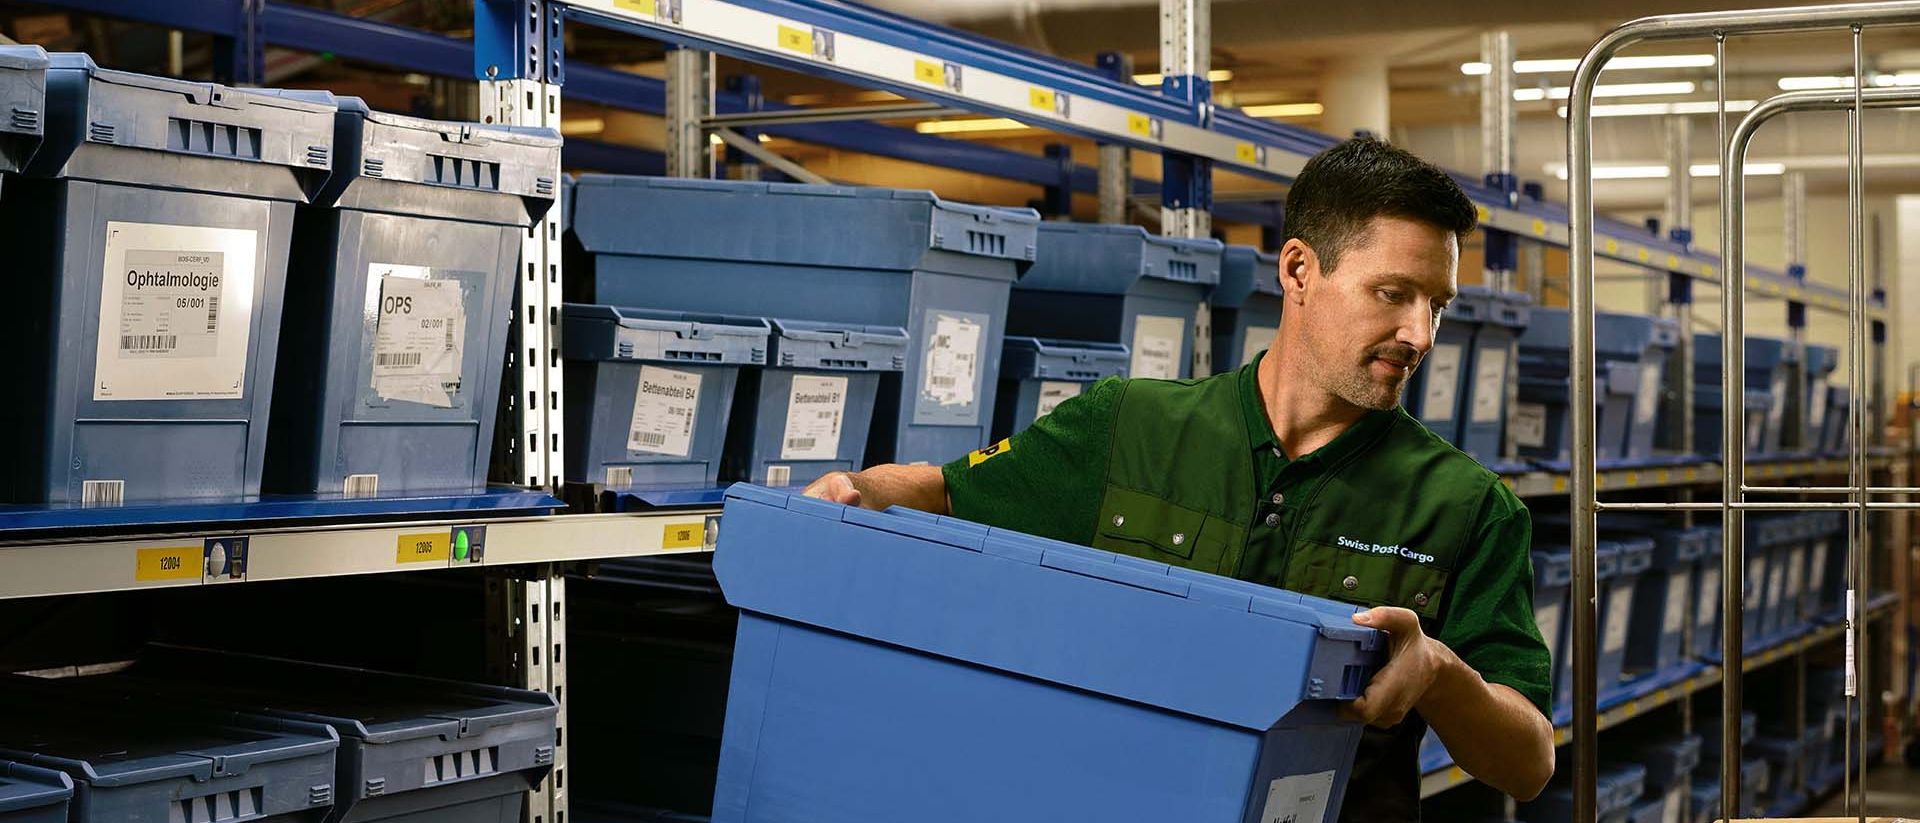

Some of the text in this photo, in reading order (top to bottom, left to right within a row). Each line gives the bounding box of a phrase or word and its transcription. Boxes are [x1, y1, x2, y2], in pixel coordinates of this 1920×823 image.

[127, 270, 219, 291] Ophtalmologie
[176, 297, 205, 309] 05/001
[384, 295, 412, 315] OPS
[421, 319, 443, 329] 02/001
[642, 381, 696, 399] Bettenabteil B4
[795, 392, 841, 404] Bettenabteil B1
[416, 541, 432, 554] 12005
[1337, 536, 1434, 563] Swiss Post Cargo
[159, 556, 180, 570] 12004
